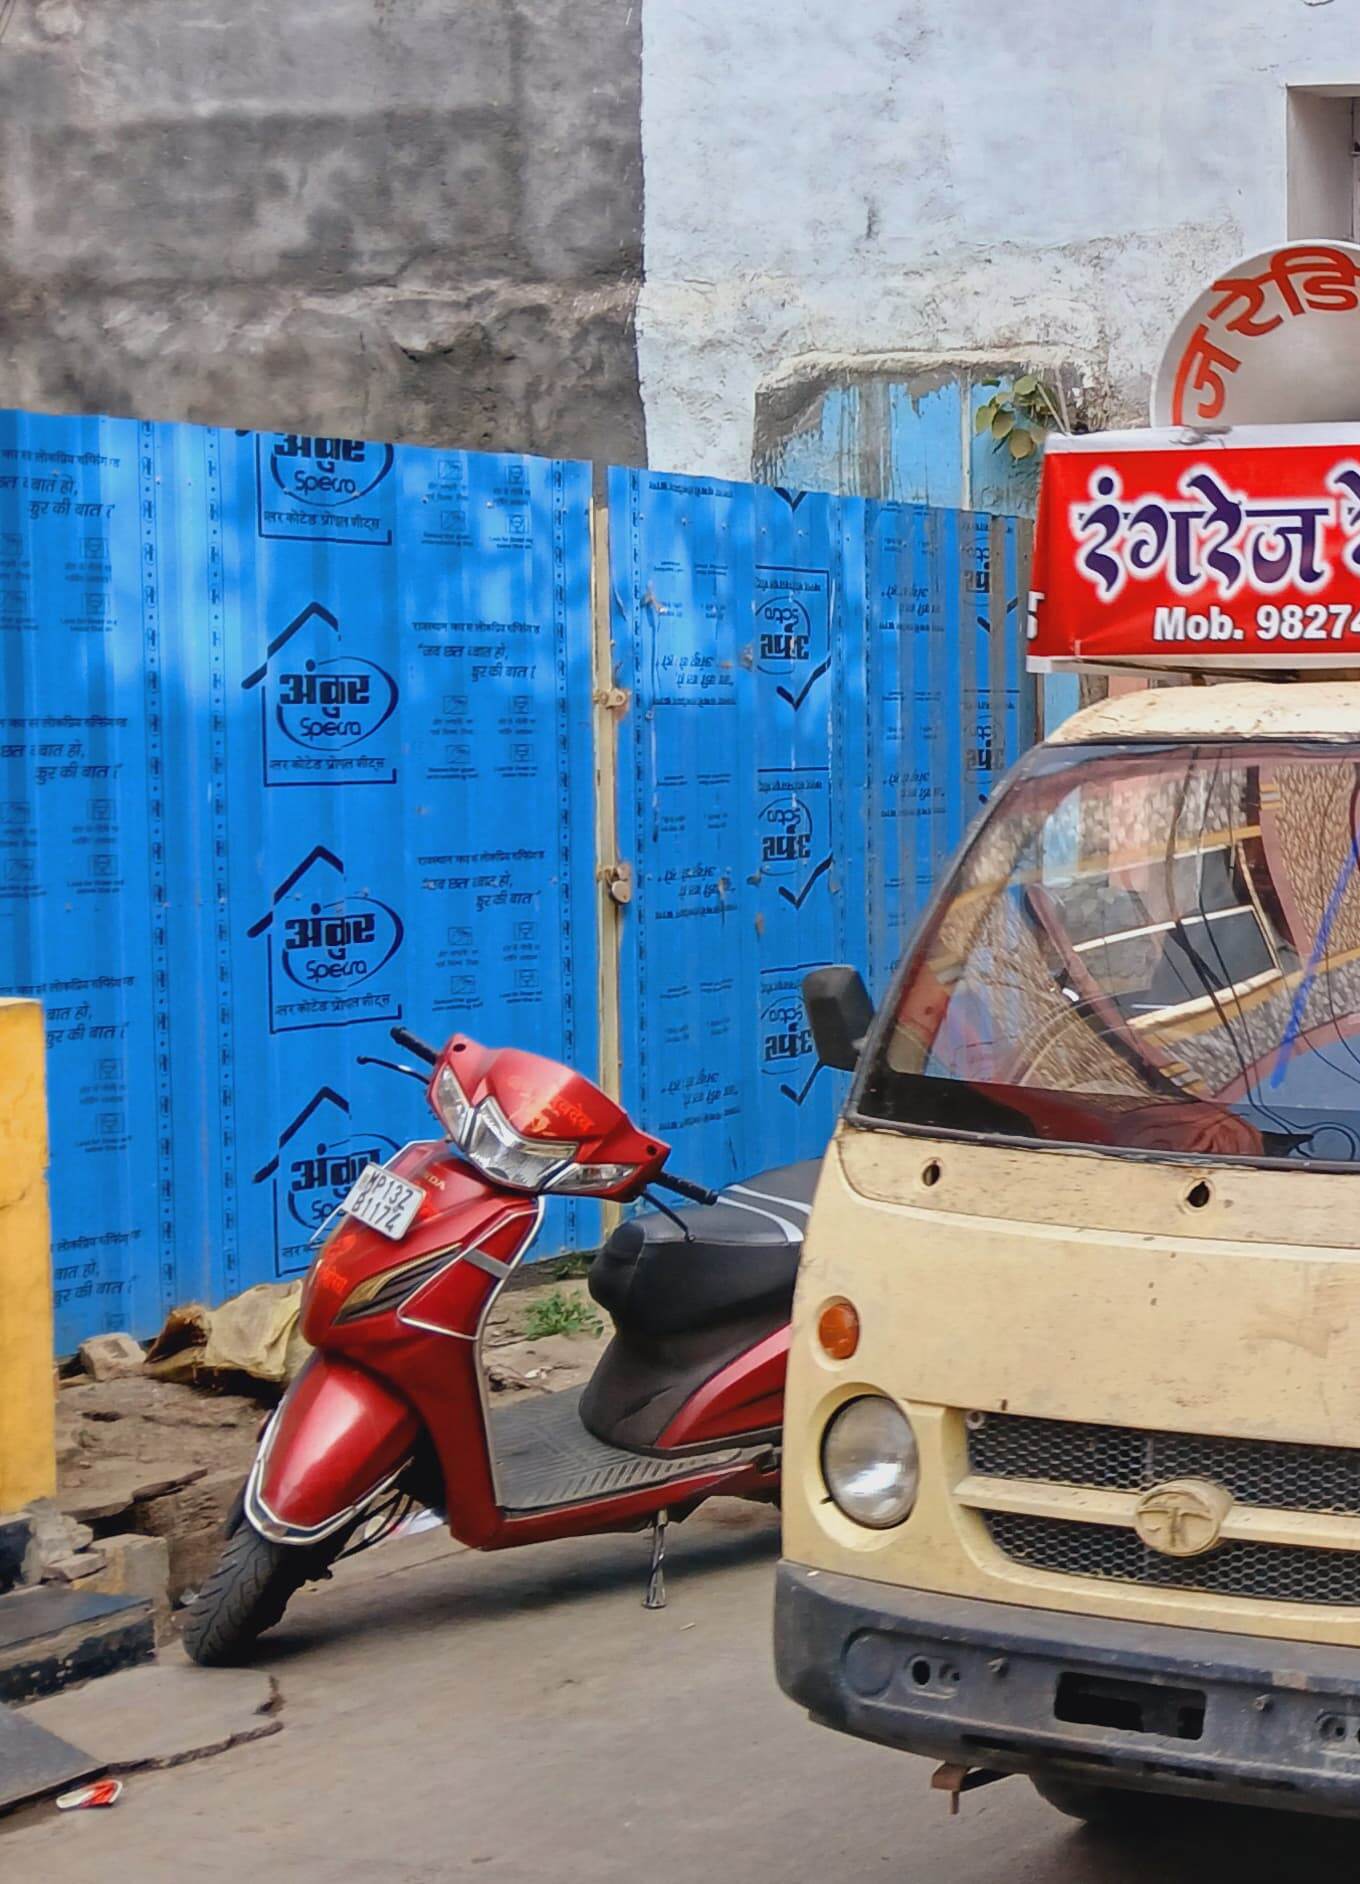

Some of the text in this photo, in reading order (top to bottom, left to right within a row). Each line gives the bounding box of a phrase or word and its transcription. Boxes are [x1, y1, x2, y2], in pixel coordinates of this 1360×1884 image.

[1078, 468, 1330, 593] रंगरेज
[1153, 606, 1243, 642] Mob.
[279, 659, 370, 719] अंकुर
[285, 903, 375, 960] अंकुर
[367, 1171, 413, 1210] MP13Z
